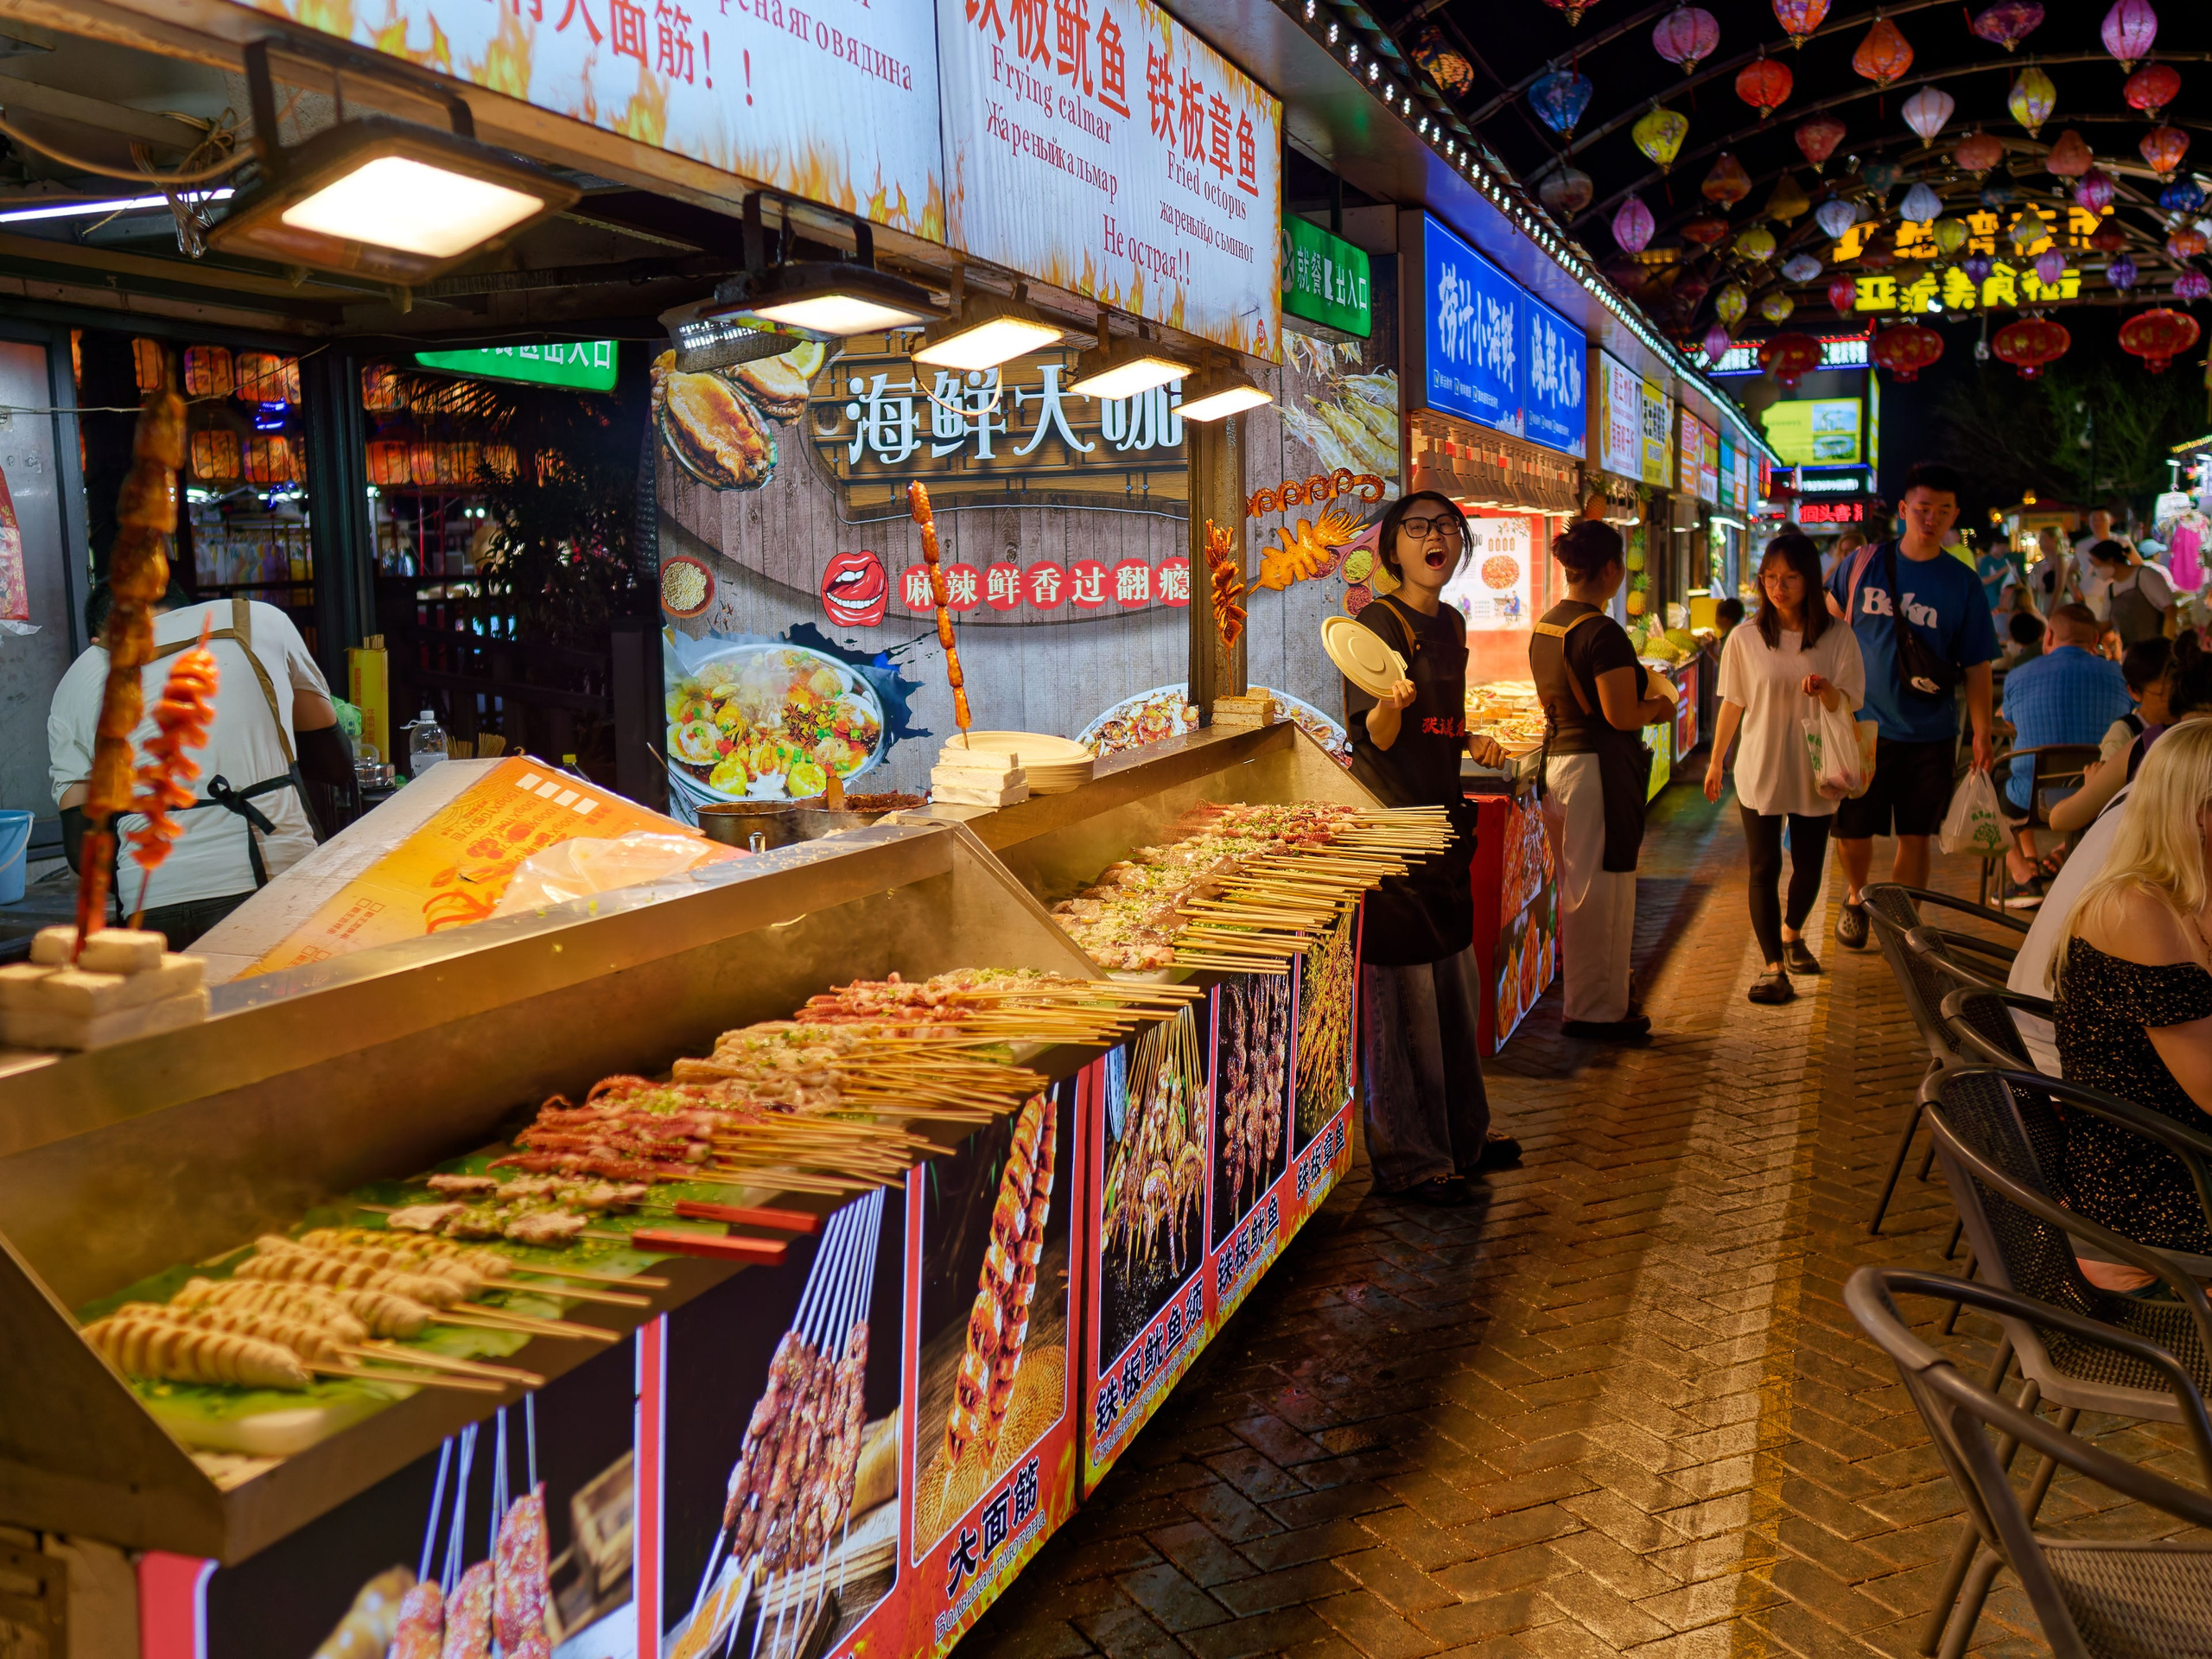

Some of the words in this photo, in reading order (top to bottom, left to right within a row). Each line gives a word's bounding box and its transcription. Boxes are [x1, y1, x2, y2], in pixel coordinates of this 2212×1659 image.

[991, 43, 1053, 118] Frying
[1058, 95, 1112, 144] calmar
[1147, 41, 1259, 198] 铁板章鱼
[1166, 149, 1200, 195] Fried
[1204, 181, 1247, 220] octopus
[1103, 213, 1124, 258] Не
[905, 563, 1190, 607] 麻辣鲜香过翻瘾
[1217, 1192, 1280, 1296] 铁板鱿鱼
[1095, 1275, 1204, 1440] 铁板鱿鱼须
[945, 1456, 1039, 1600] 大面筋
[935, 1565, 995, 1646] Большая
